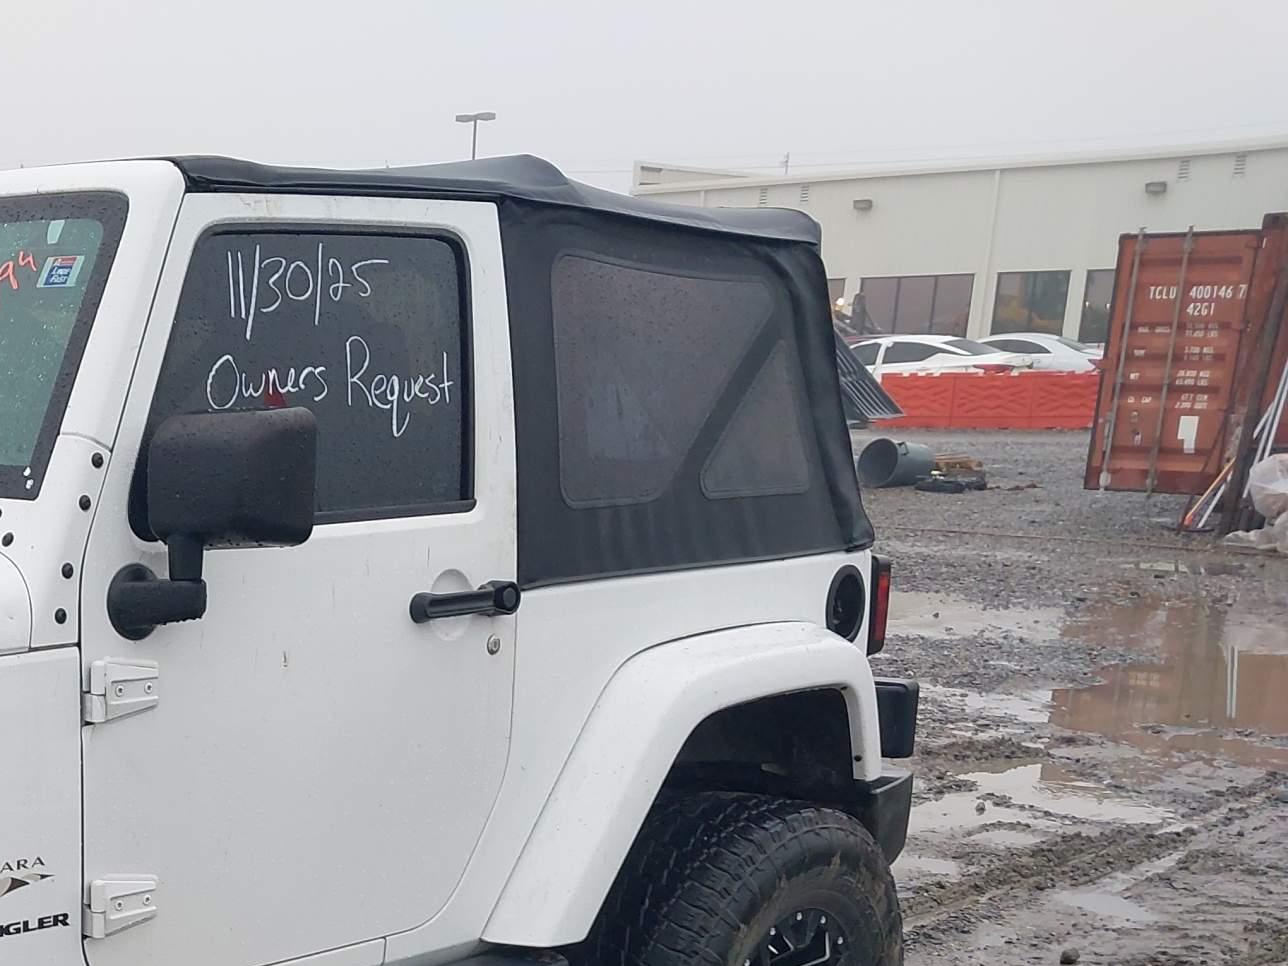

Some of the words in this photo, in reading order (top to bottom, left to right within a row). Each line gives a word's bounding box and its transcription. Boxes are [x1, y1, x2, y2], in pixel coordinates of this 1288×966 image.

[227, 243, 390, 340] 11/30/25
[1149, 286, 1178, 299] TCLU
[1189, 285, 1234, 299] 400146
[207, 354, 329, 410] Owners
[346, 336, 455, 438] Request
